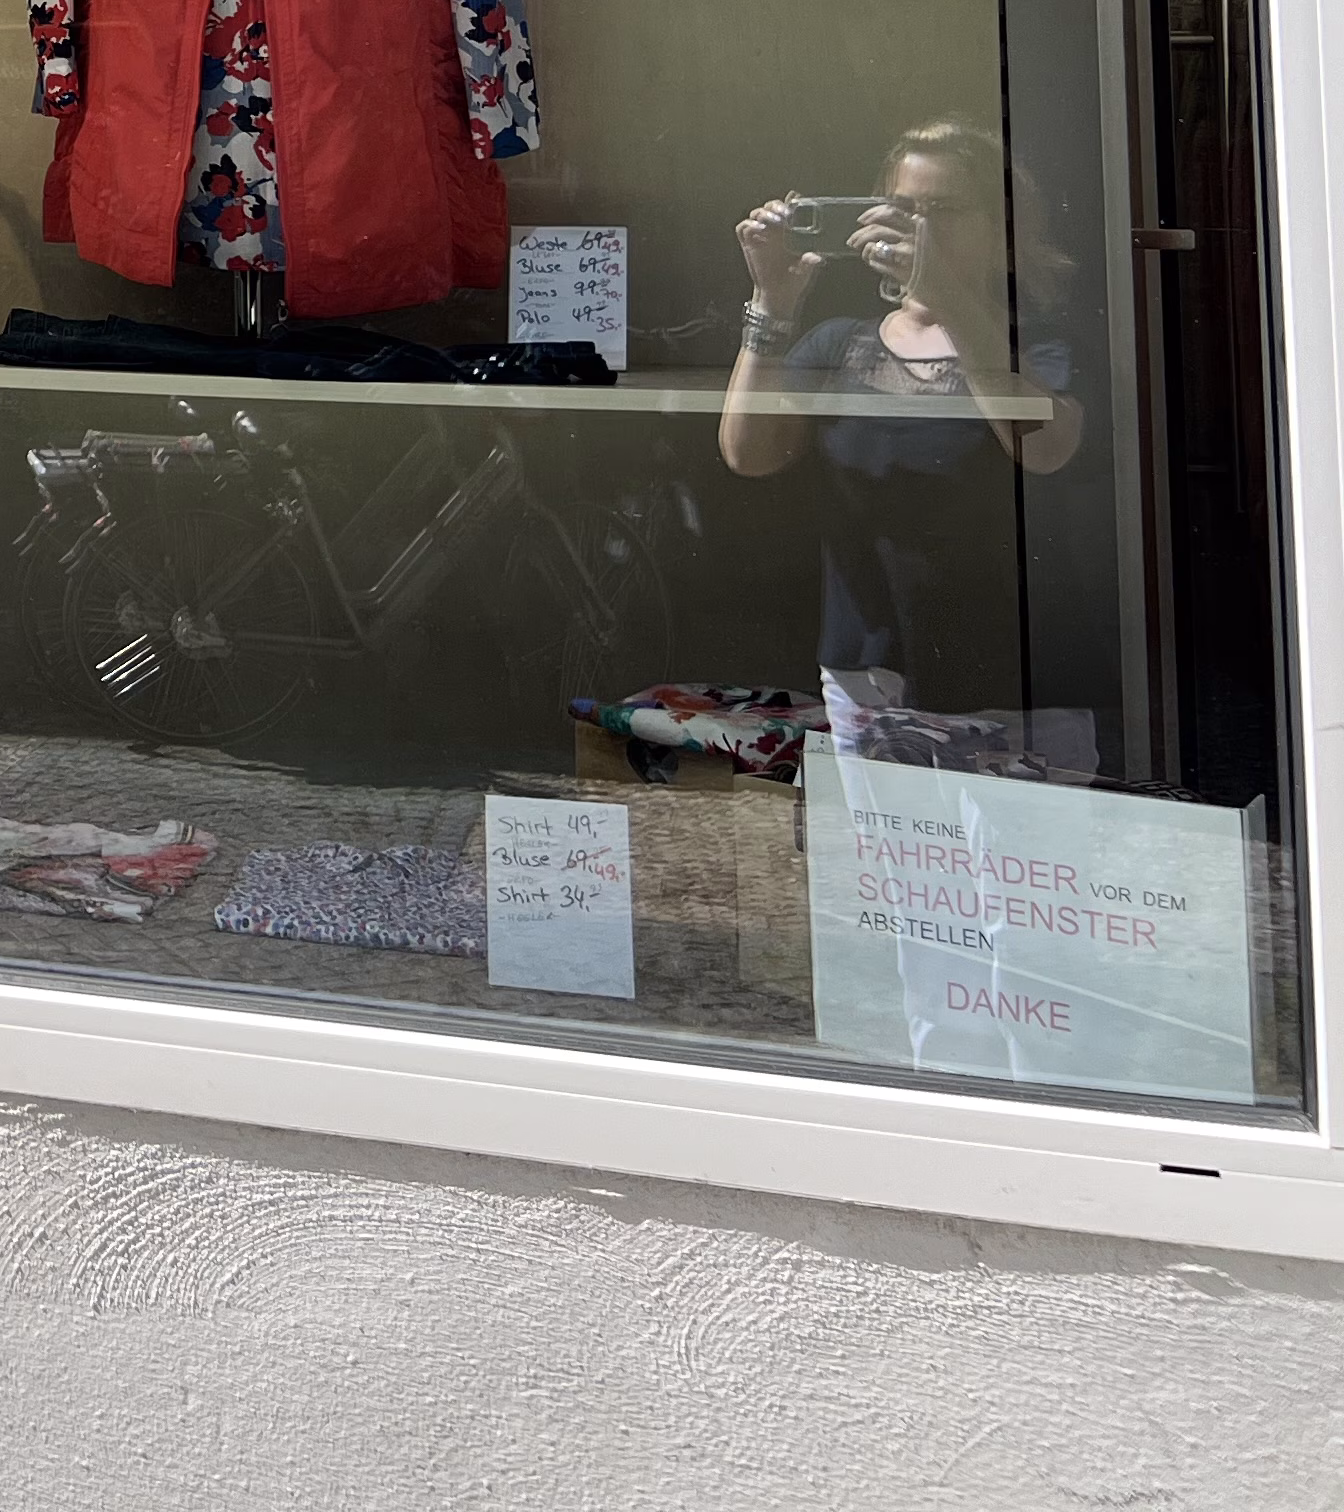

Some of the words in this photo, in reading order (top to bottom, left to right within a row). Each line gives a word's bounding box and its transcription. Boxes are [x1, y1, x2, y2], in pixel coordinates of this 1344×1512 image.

[519, 235, 569, 252] Weste
[516, 257, 563, 274] Bluse
[498, 815, 553, 836] Shirt
[853, 810, 903, 831] BITTE
[912, 819, 967, 841] KEINE
[492, 846, 551, 867] Bluse
[856, 834, 1079, 895] FAHRRÄDER
[1089, 883, 1132, 904] VOR
[1142, 891, 1187, 912] DEM
[496, 885, 550, 904] Shirt
[857, 873, 1158, 949] SCHAUFENSTER
[857, 910, 995, 952] ABSTELLEN
[946, 981, 1072, 1033] DANKE
